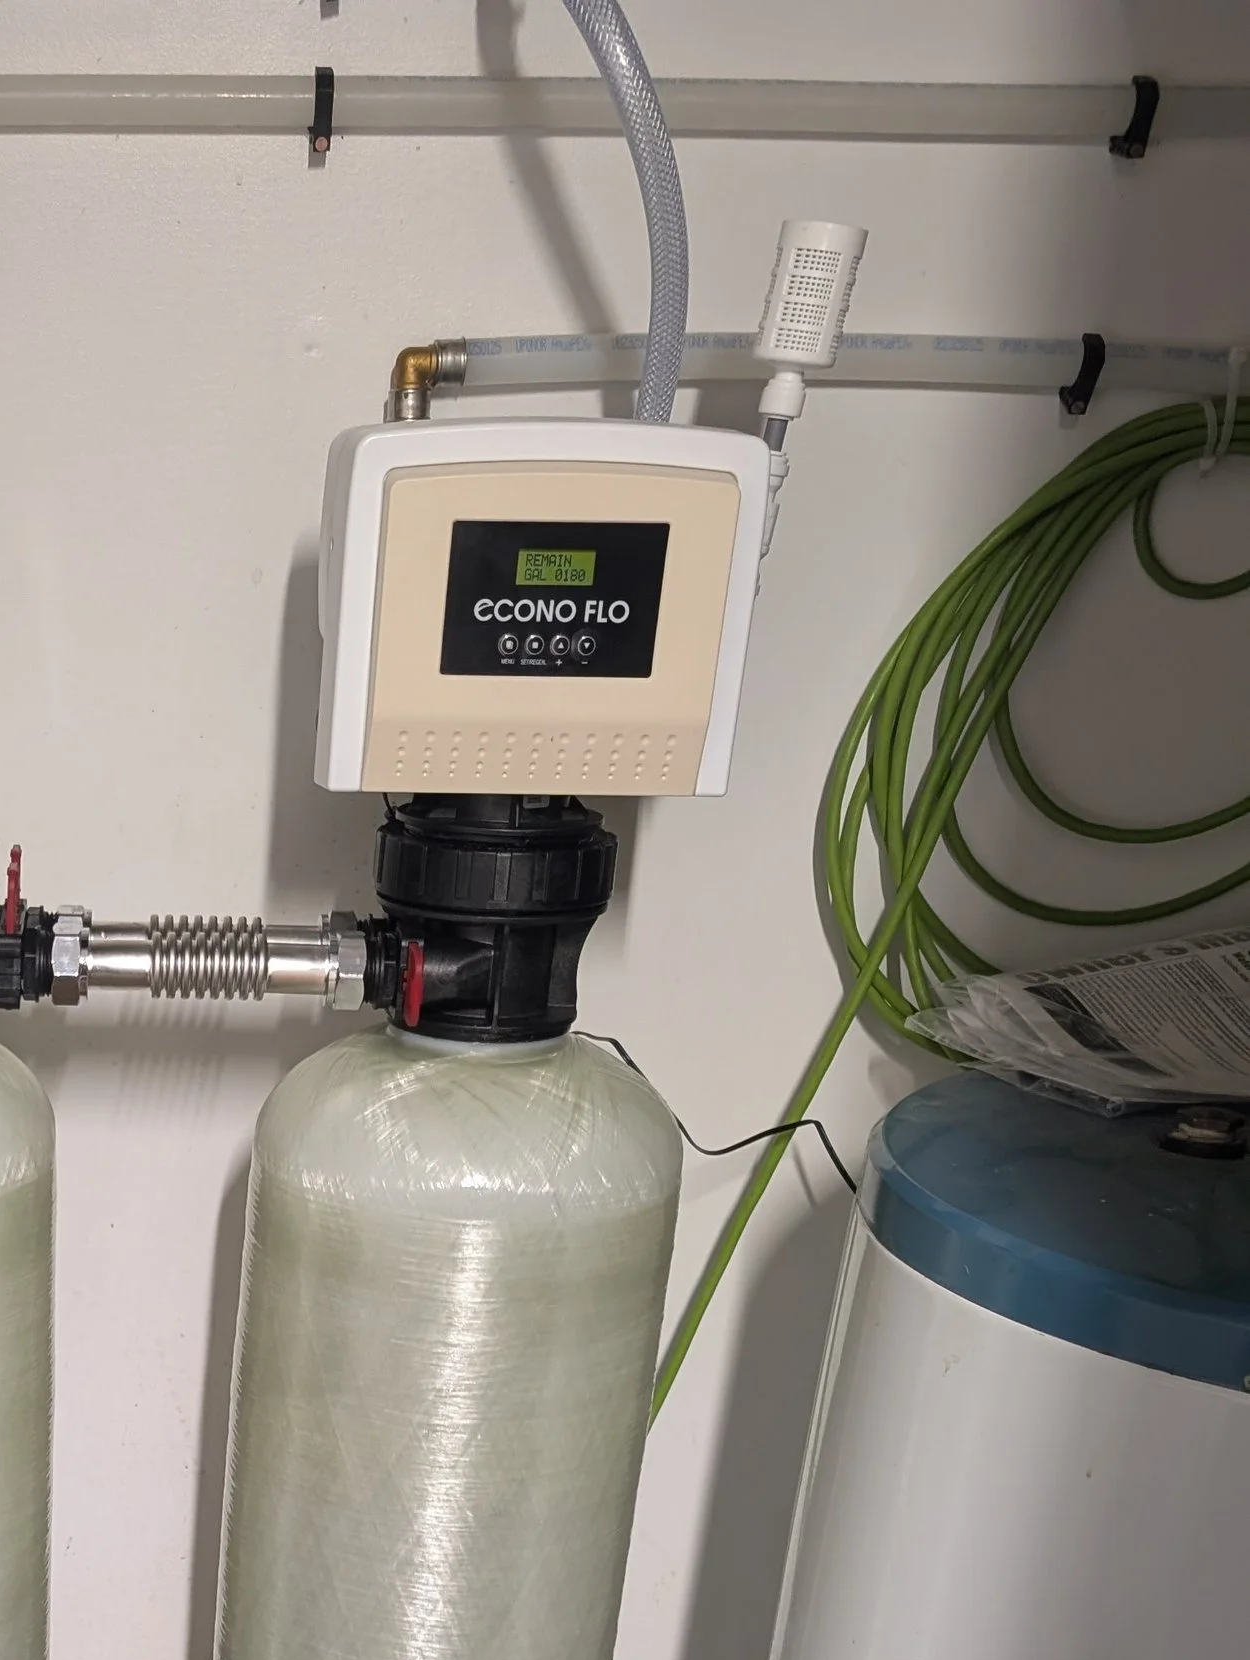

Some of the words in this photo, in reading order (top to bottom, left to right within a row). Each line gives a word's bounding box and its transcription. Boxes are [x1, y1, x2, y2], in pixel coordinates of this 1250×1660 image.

[526, 553, 573, 568] REMAIN
[524, 567, 547, 582] GAL
[554, 568, 587, 582] 0180
[584, 600, 630, 624] FLO
